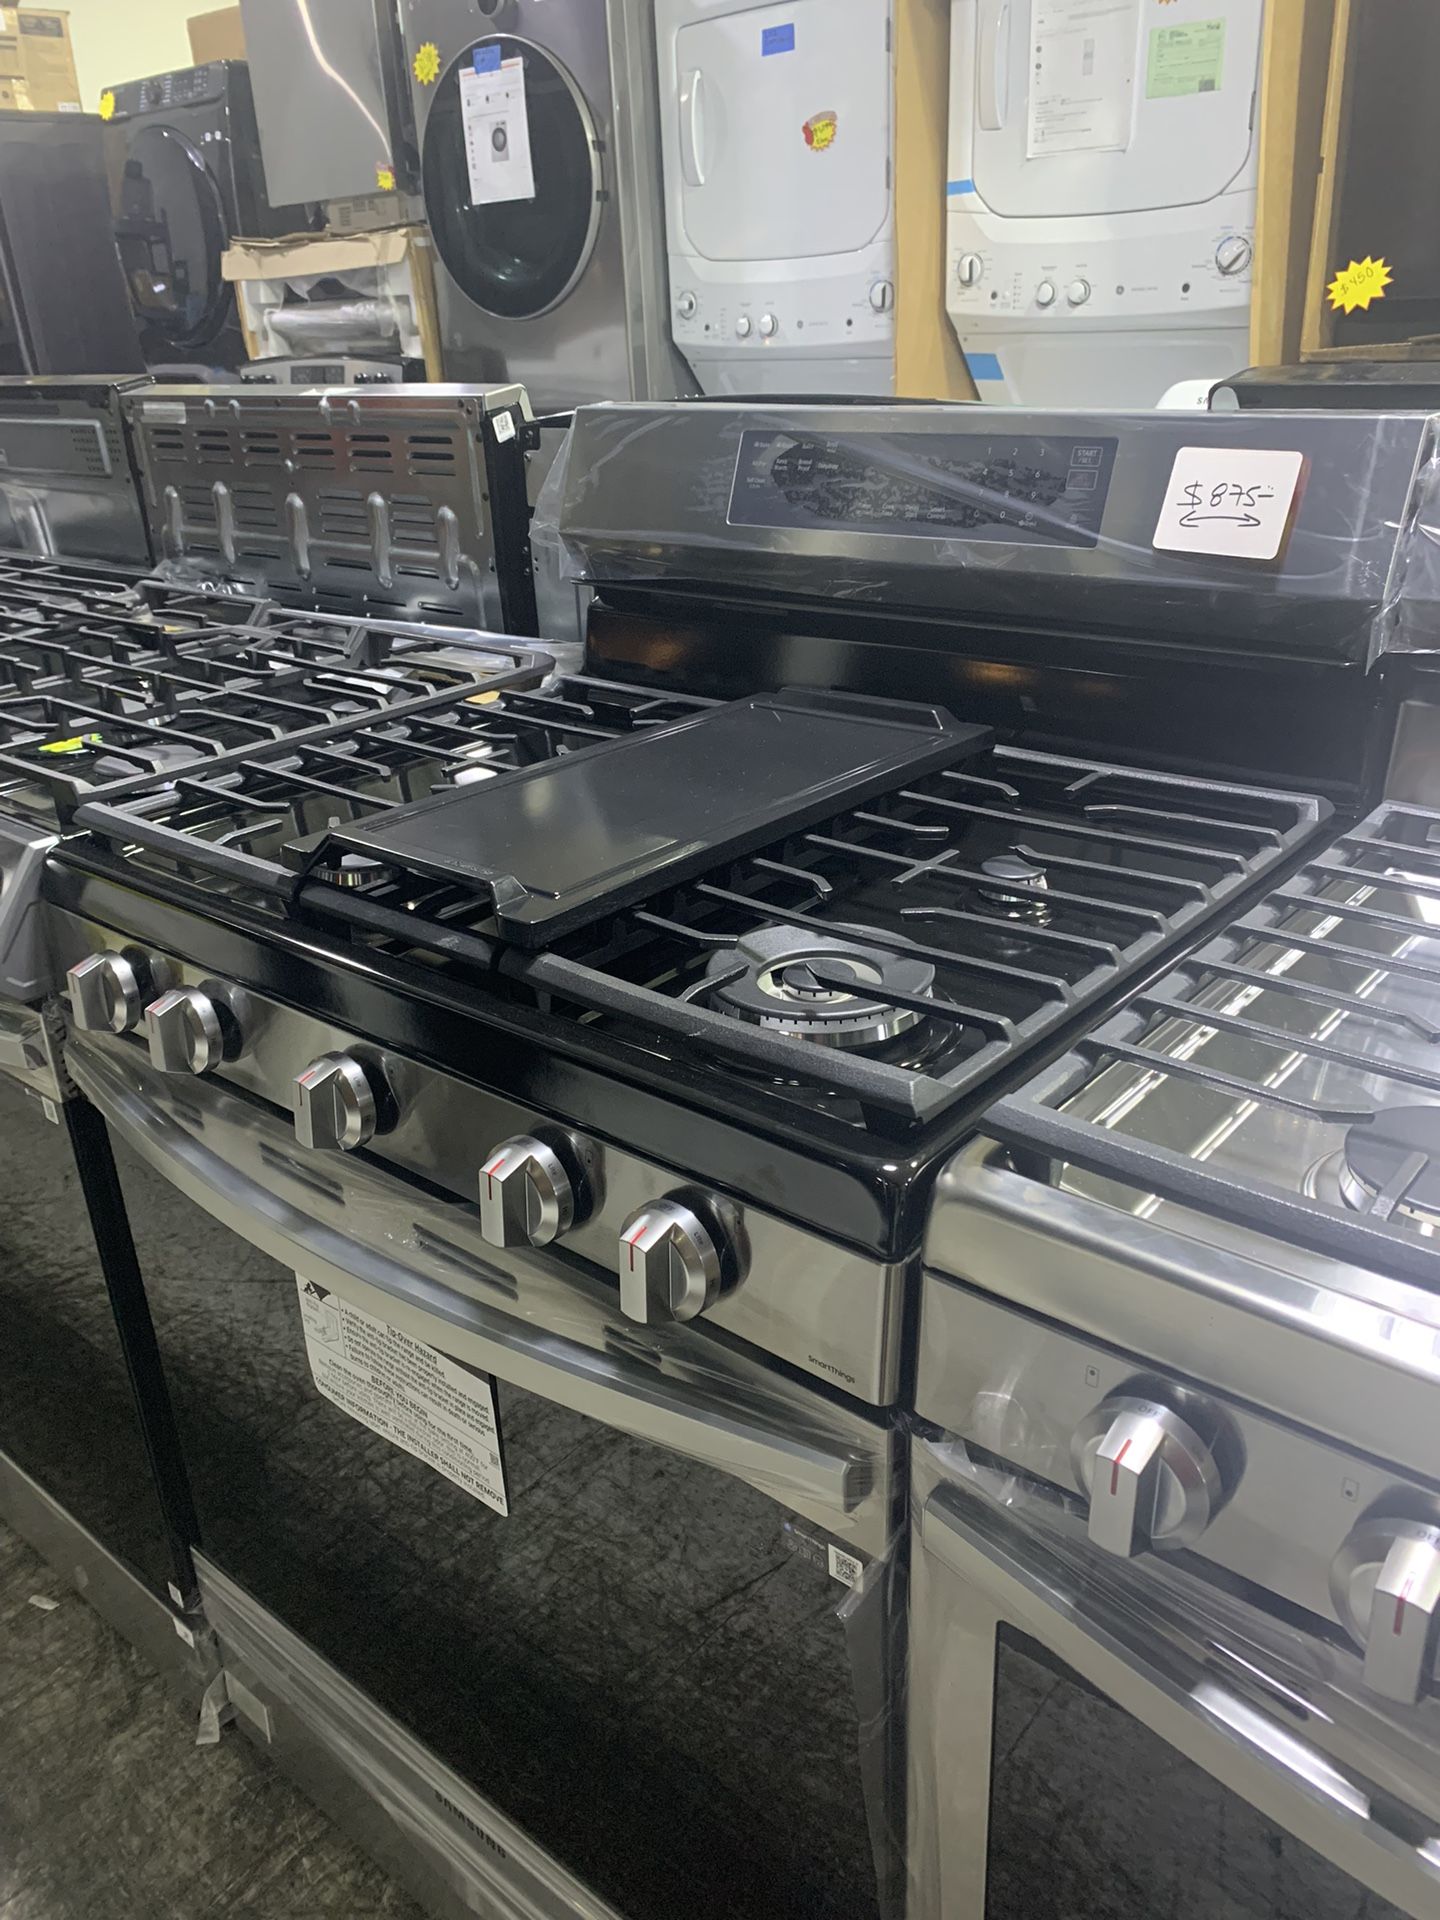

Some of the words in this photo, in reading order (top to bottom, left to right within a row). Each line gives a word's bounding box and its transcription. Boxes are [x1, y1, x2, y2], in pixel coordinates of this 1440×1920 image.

[1341, 267, 1374, 294] $450
[386, 1324, 413, 1350] Tip-Over
[414, 1341, 437, 1366] Hazard
[808, 1355, 855, 1384] SmartThings
[370, 1373, 394, 1396] BEFORE
[395, 1390, 409, 1406] YOU
[408, 1399, 428, 1419] BEGIN
[345, 1394, 388, 1430] INFORMATION
[393, 1424, 407, 1440] THE
[406, 1432, 439, 1462] INSTALLER
[439, 1455, 460, 1476] SHALL
[460, 1469, 474, 1486] NOT
[474, 1479, 504, 1506] REMOVE
